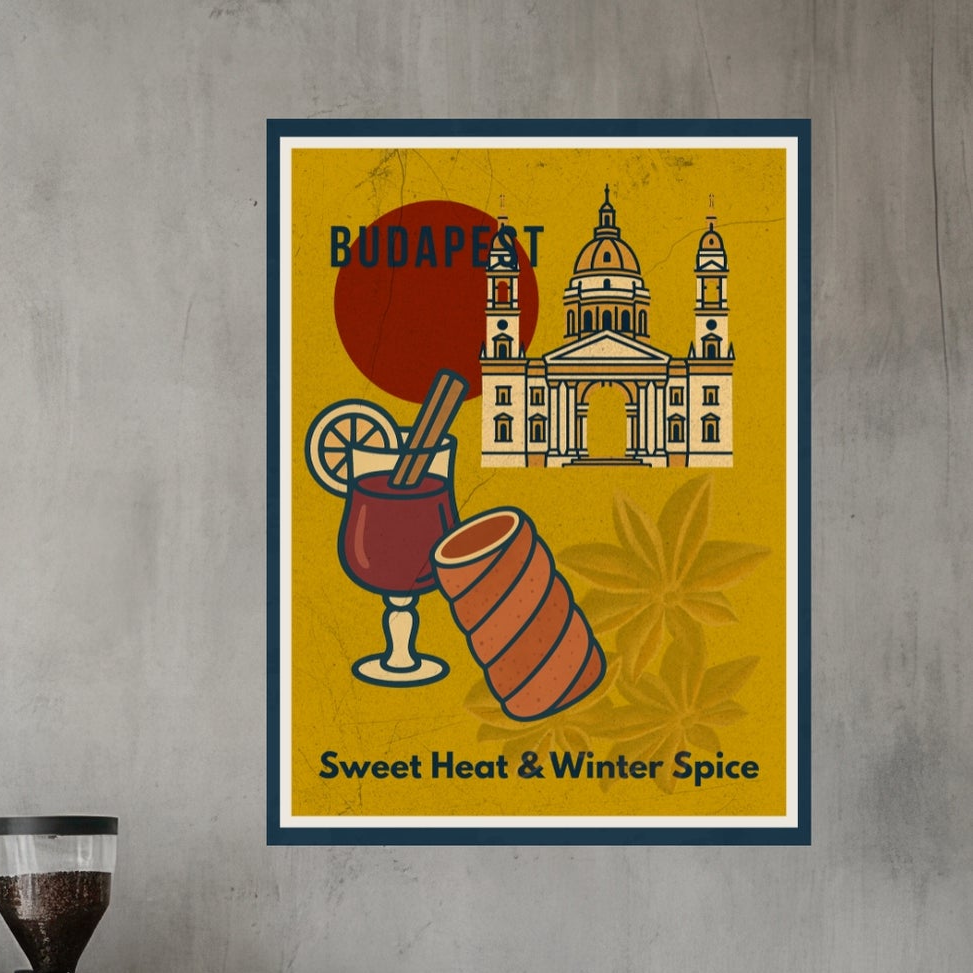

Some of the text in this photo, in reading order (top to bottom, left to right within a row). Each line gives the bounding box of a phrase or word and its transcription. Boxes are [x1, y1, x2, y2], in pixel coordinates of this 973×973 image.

[330, 225, 544, 268] BUDAPEST
[319, 751, 760, 787] Sweet Heat & Winter Spice
